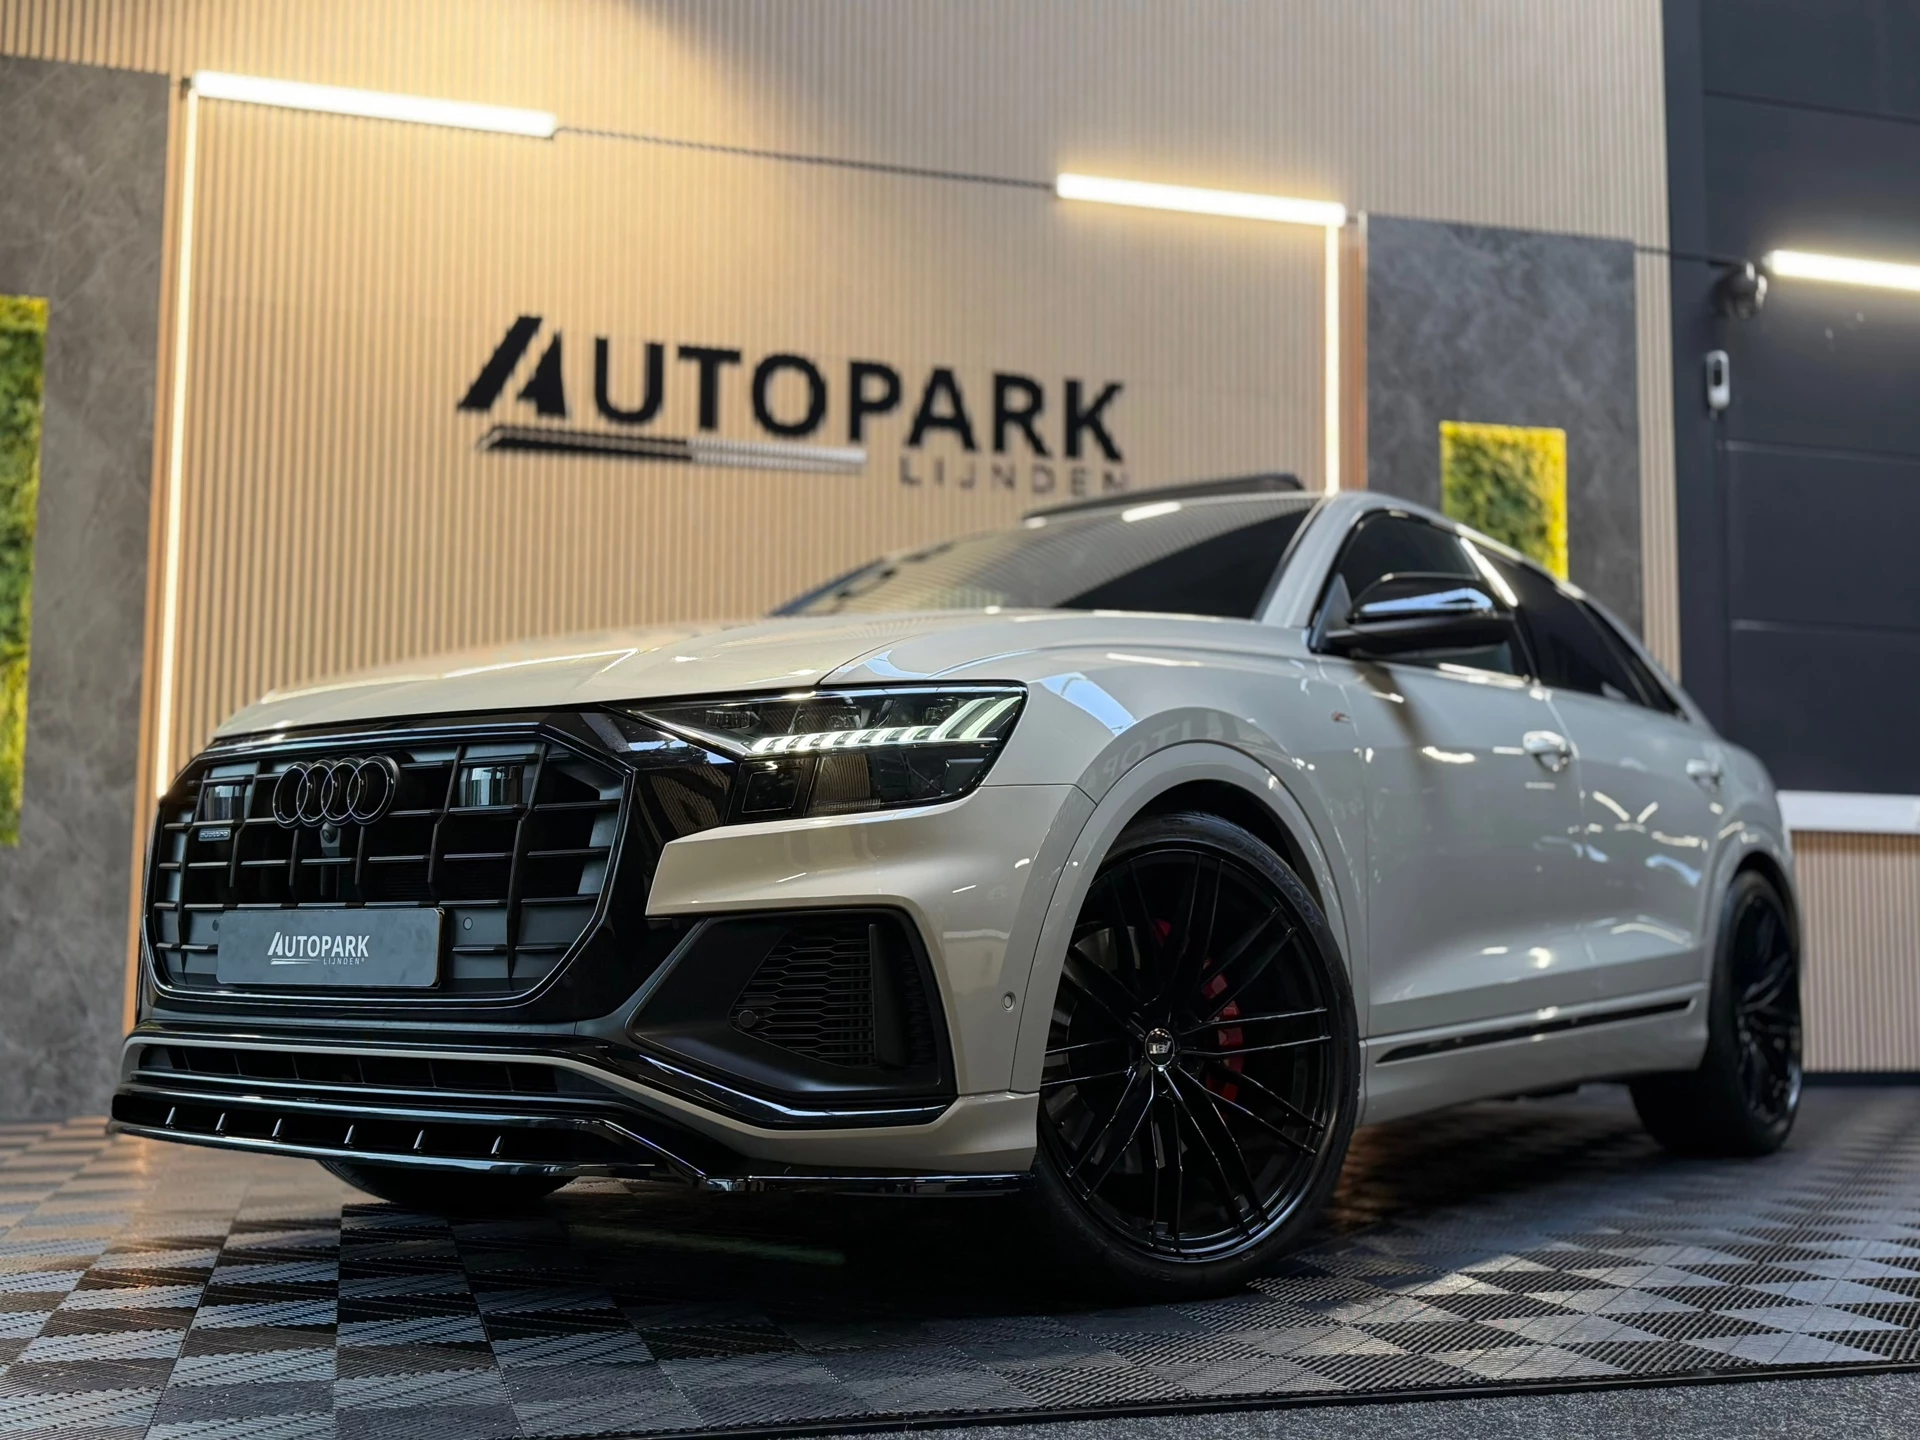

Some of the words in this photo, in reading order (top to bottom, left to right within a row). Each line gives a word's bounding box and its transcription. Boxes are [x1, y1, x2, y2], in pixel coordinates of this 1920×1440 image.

[457, 315, 1124, 463] AUTOPARK
[900, 456, 1128, 497] LIJNDEN
[267, 931, 370, 957] AUTOPARK
